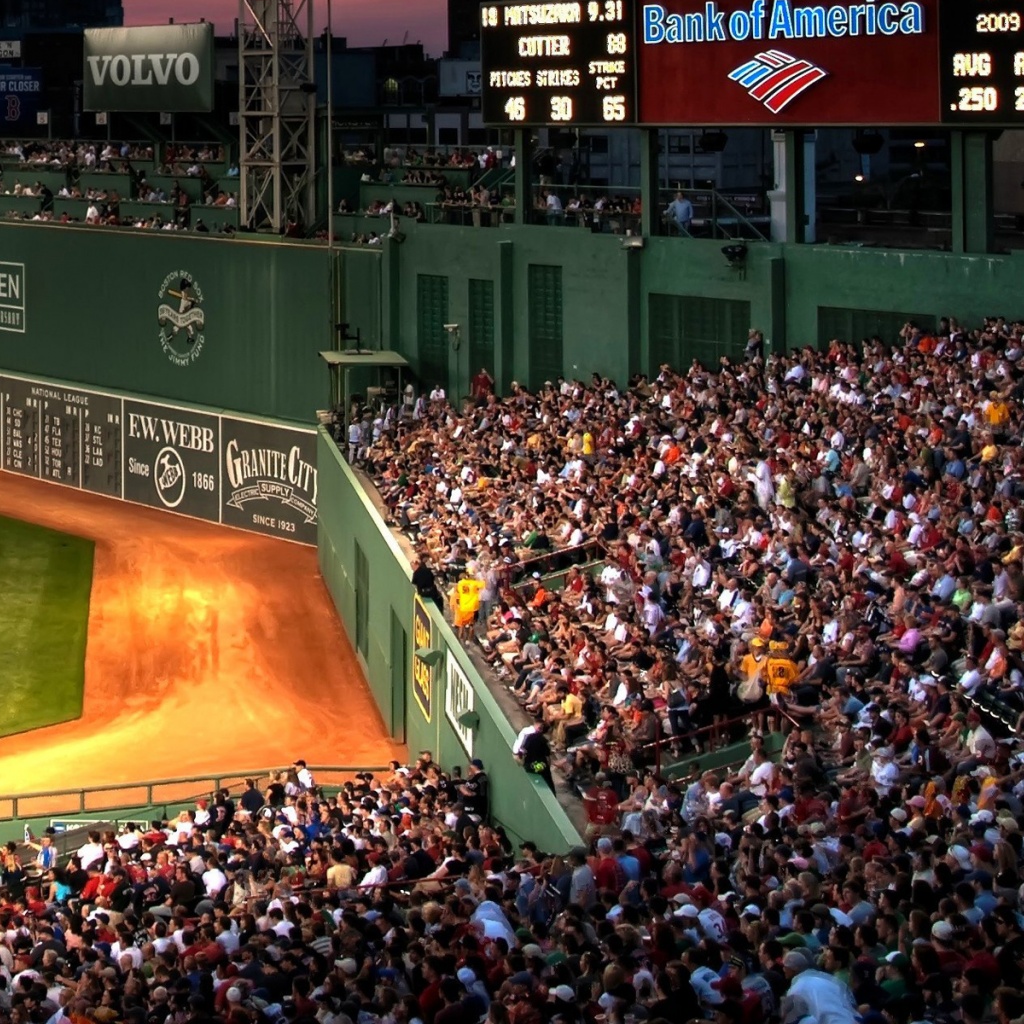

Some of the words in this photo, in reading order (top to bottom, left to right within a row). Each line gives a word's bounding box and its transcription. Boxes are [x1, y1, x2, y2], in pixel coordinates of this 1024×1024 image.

[588, 0, 622, 22] 9.31
[642, 1, 726, 43] Bank
[976, 12, 1021, 33] 2009
[518, 35, 570, 57] CUTTER
[87, 52, 200, 86] VOLVO
[588, 61, 626, 74] STRIKE
[953, 53, 991, 76] AVG
[8, 80, 40, 92] CLOSER
[489, 71, 531, 87] PITCHES
[536, 70, 580, 87] STRIKES
[596, 77, 618, 89] PCT
[504, 97, 526, 121] 46
[550, 96, 573, 121] 30
[602, 96, 626, 121] 65
[950, 87, 997, 111] .250
[158, 270, 179, 299] BOSTON
[179, 270, 192, 283] RED
[193, 281, 204, 303] SOX
[168, 354, 189, 367] JIMMY
[191, 335, 205, 362] FUND
[31, 387, 61, 401] NATIONAL
[64, 393, 89, 405] LEAGUE
[52, 426, 61, 436] FLA
[93, 435, 102, 446] STL
[128, 413, 159, 443] F.W.
[160, 419, 214, 453] WEBB
[52, 437, 61, 447] TEX
[93, 446, 102, 456] LAA
[93, 456, 103, 467] LAD
[128, 457, 149, 477] Since
[226, 439, 286, 488] GRANITE
[192, 471, 214, 491] 1866
[235, 488, 259, 500] ELECTRIC
[261, 483, 290, 497] SUPPLY
[290, 496, 314, 515] COMPANY
[252, 513, 276, 527] SINCE
[278, 520, 296, 533] 1923
